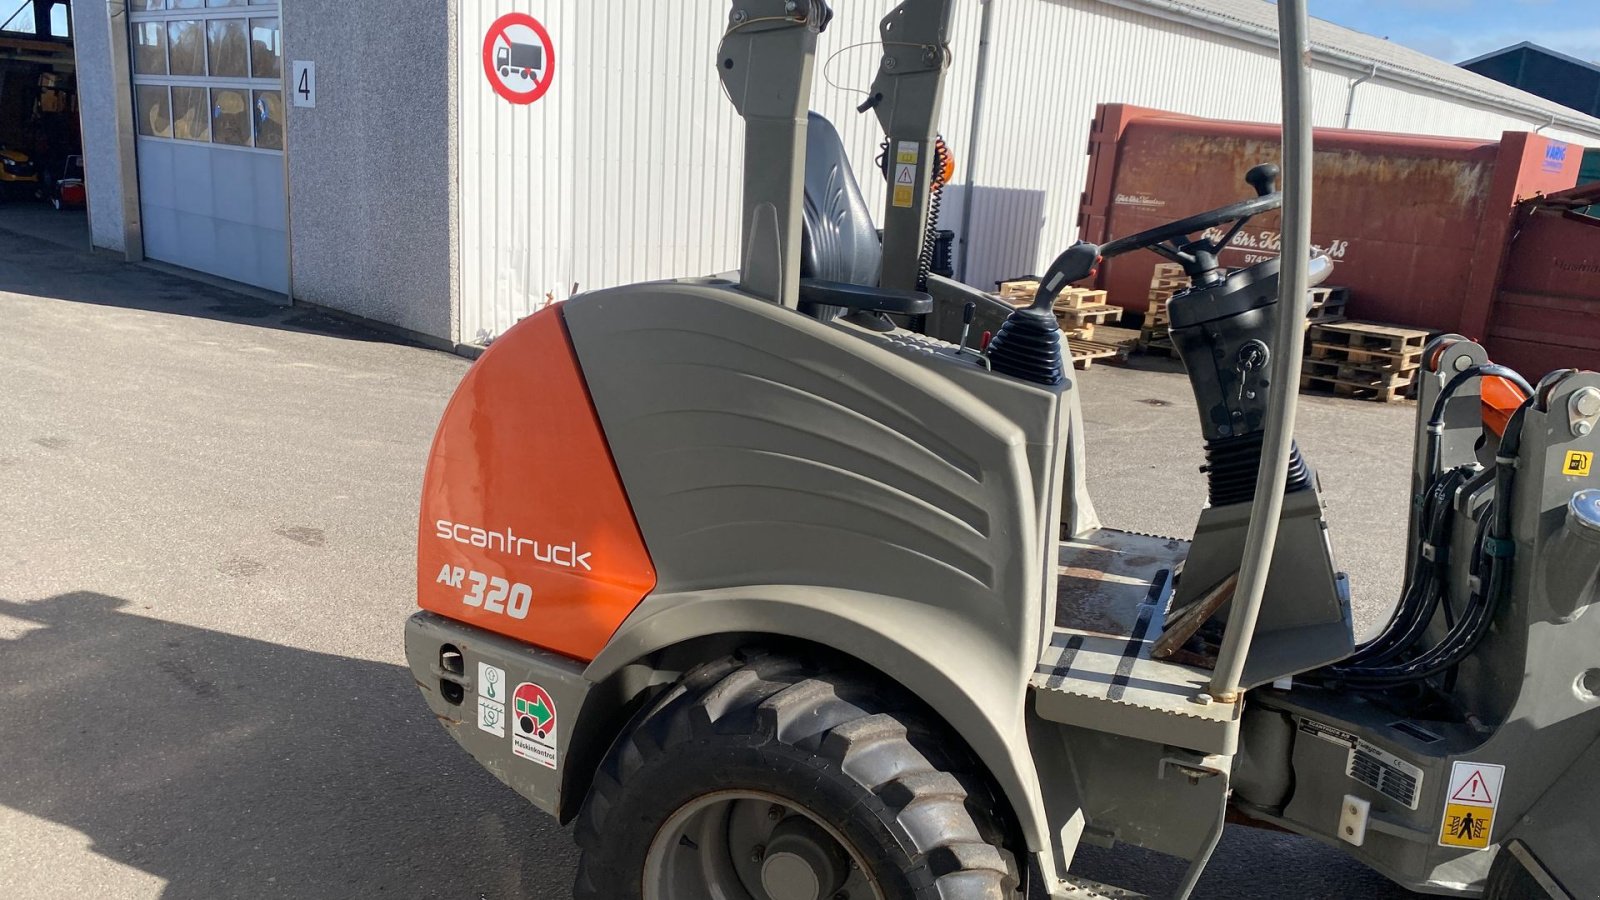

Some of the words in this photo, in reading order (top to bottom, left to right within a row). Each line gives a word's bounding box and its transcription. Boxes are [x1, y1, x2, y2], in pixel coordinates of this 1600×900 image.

[298, 68, 310, 100] 4
[1232, 230, 1258, 248] Chr.
[436, 519, 592, 571] scantruck
[436, 563, 466, 589] AR
[462, 570, 533, 620] 320
